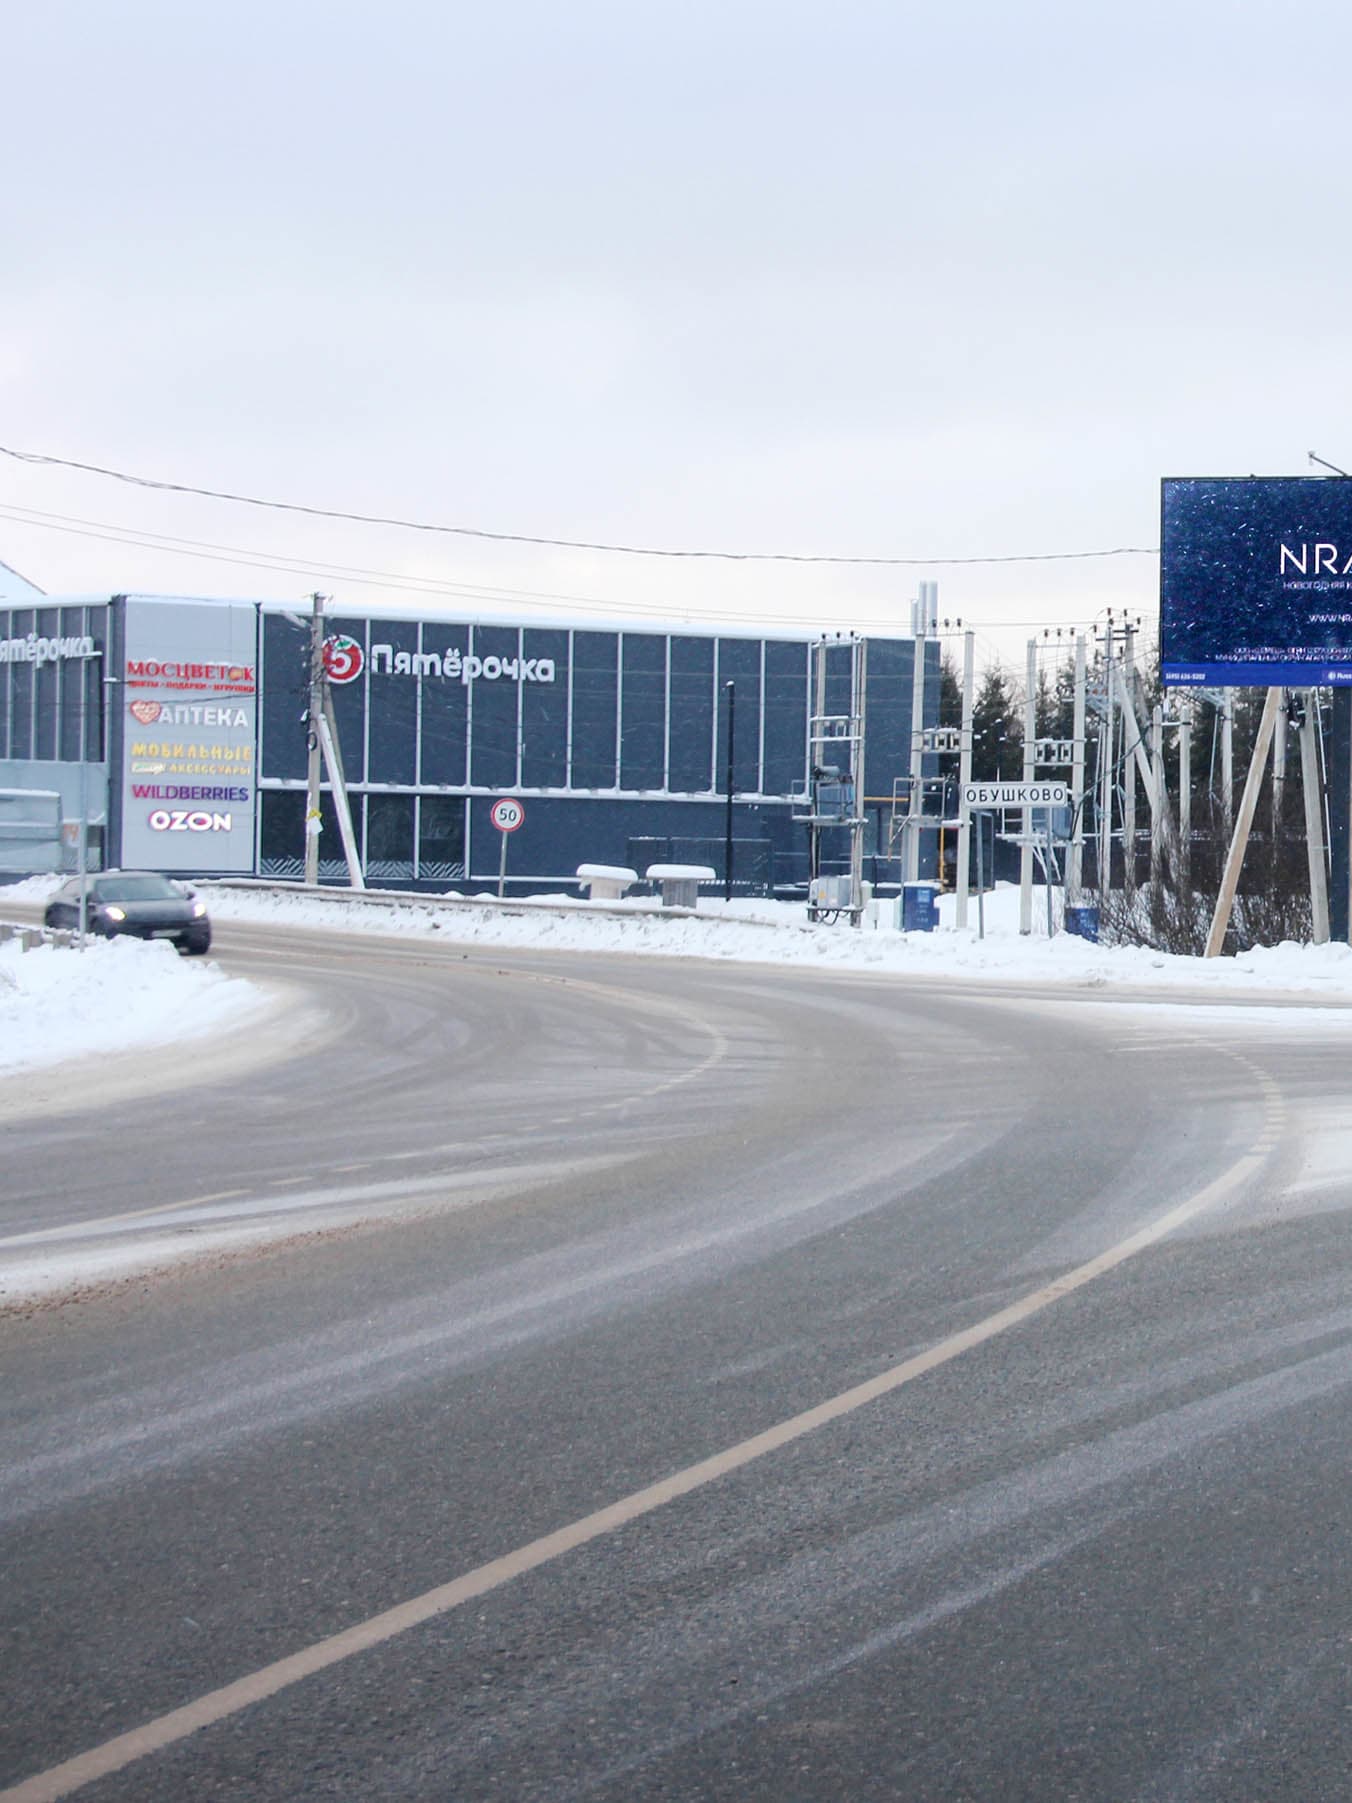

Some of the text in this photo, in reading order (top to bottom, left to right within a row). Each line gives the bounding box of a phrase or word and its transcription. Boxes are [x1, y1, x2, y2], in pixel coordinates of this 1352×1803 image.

[0, 633, 95, 668] ятёрочка
[127, 660, 255, 682] МОСЦВЕТОК
[371, 644, 555, 684] Пятёрочка
[158, 704, 249, 727] АПТЕКА
[132, 742, 252, 761] МОБИЛЬНЫЕ
[132, 784, 249, 802] WILDBERRIES
[966, 787, 1064, 803] ОБУШКОВО
[148, 809, 233, 832] OZON
[499, 807, 518, 822] 50
